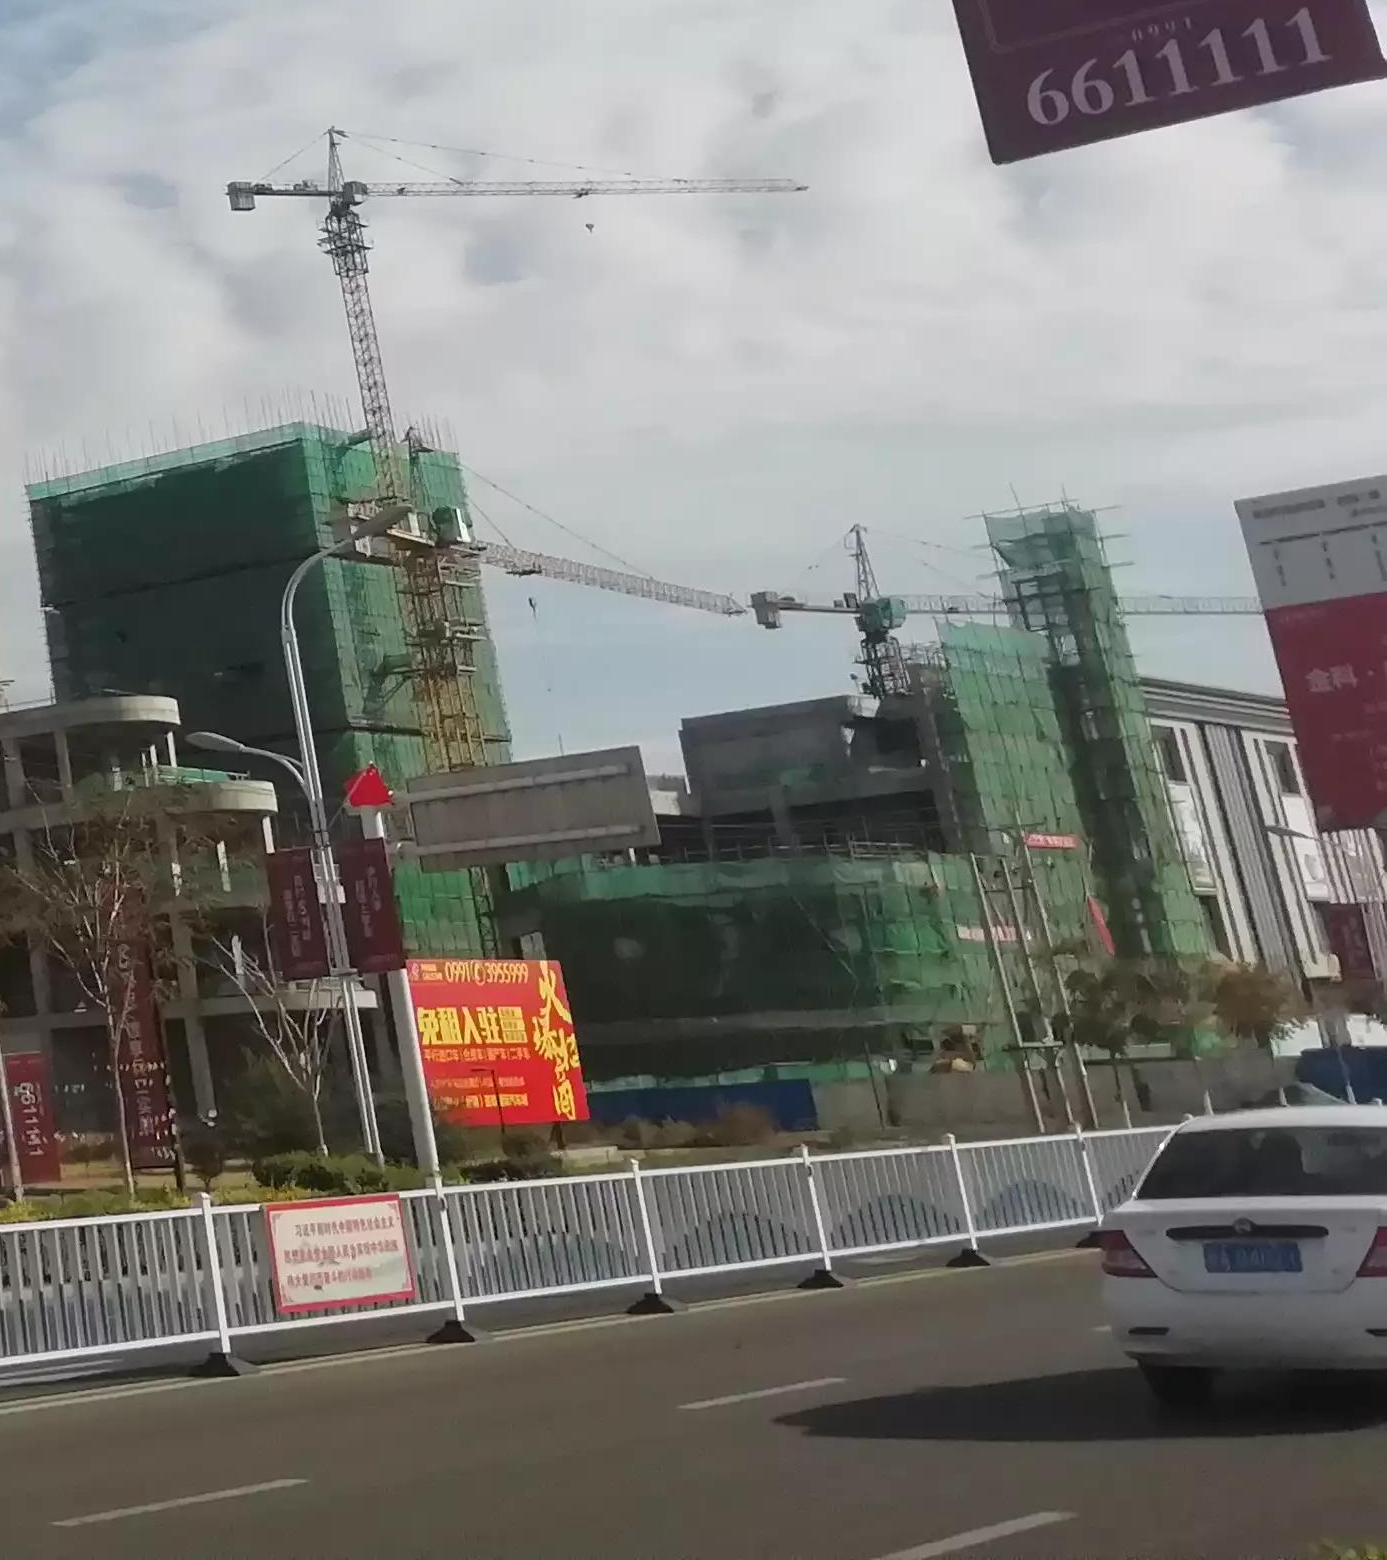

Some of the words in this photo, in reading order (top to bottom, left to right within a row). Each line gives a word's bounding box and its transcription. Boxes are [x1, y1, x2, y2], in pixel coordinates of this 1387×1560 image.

[1027, 7, 1332, 126] 6611111
[417, 1006, 502, 1045] 免租入驻
